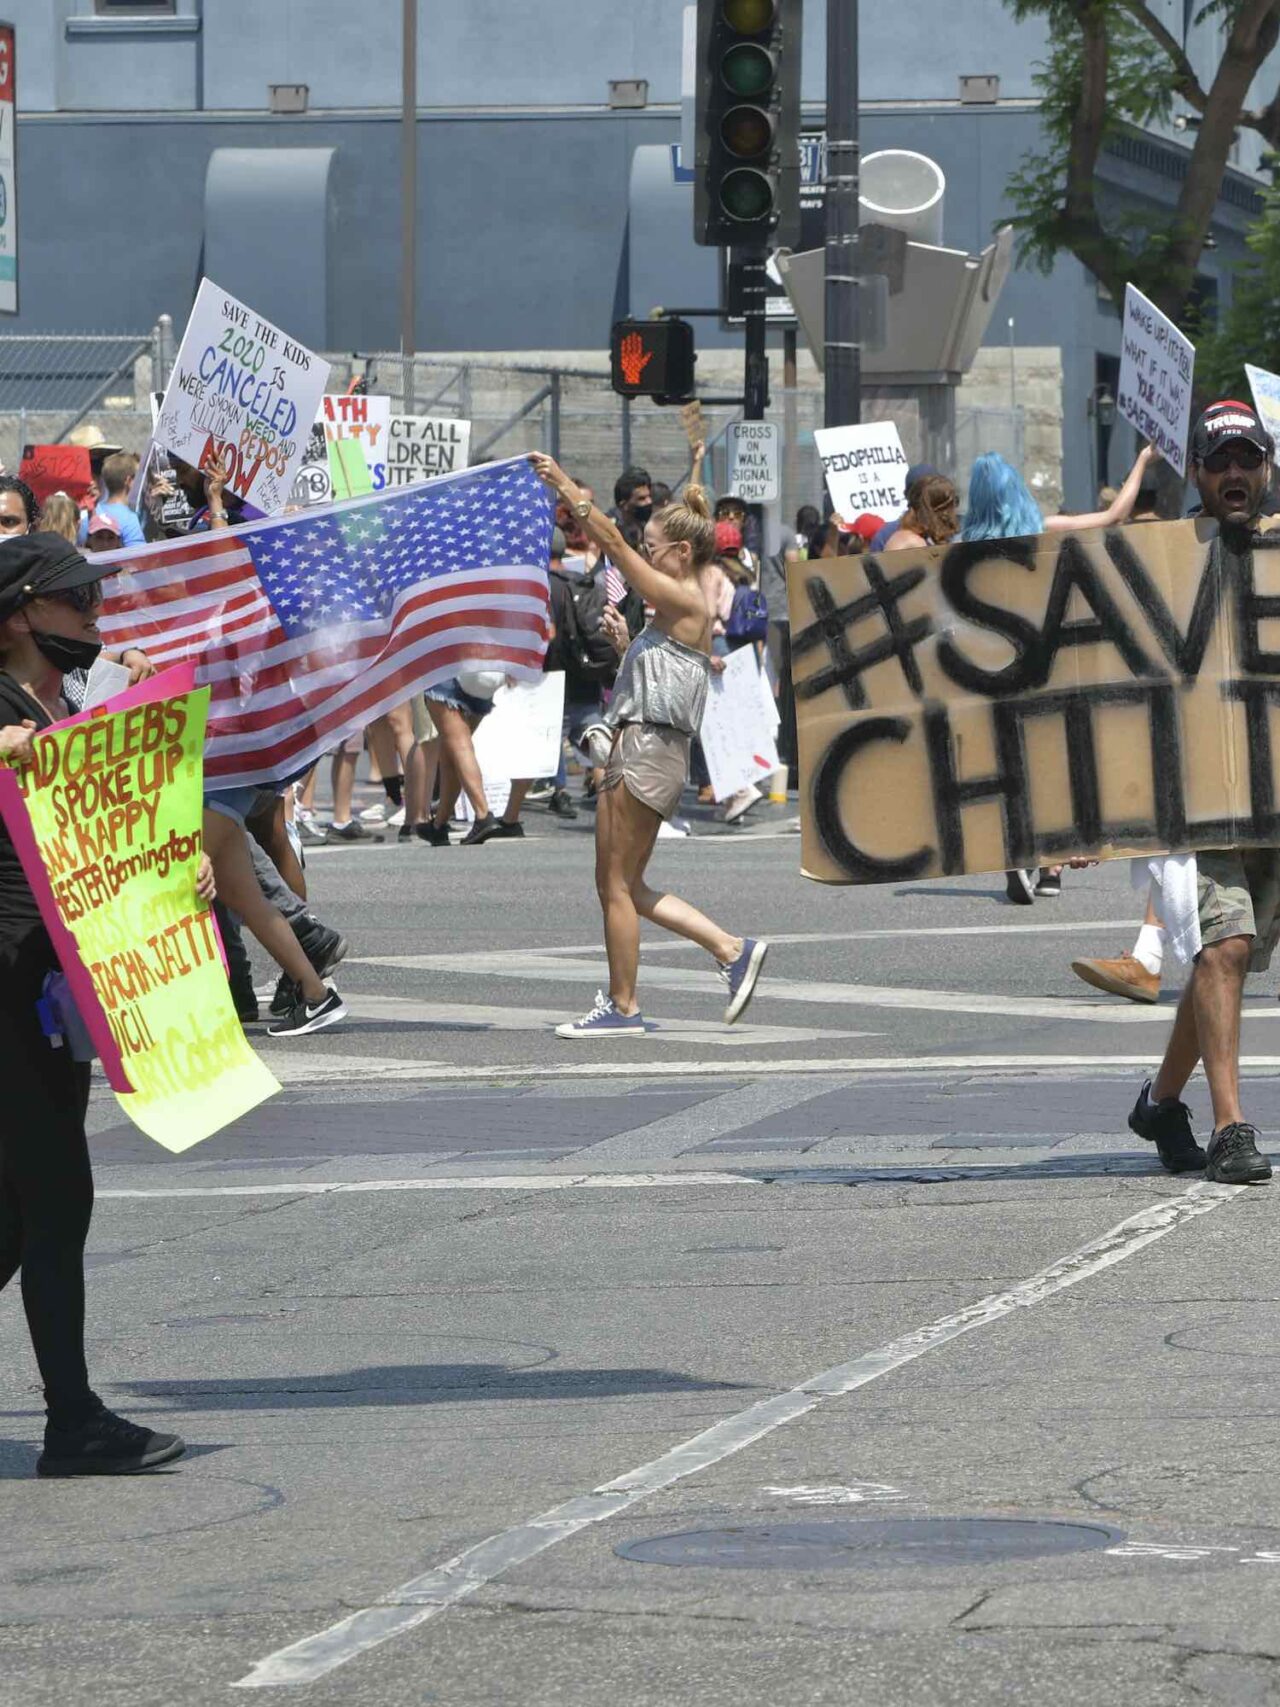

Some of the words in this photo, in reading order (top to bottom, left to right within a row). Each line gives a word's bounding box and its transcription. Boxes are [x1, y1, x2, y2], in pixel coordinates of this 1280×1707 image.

[221, 300, 250, 330] SAVE
[254, 321, 279, 350] THE
[282, 340, 312, 372] KIDS
[217, 327, 266, 374] 2020
[270, 366, 286, 391] IS
[1125, 336, 1148, 369] WHAT
[199, 345, 297, 438] CANCELED
[179, 368, 208, 401] WERE
[208, 393, 244, 424] SMOKIN
[246, 411, 276, 443] WEED
[278, 438, 297, 458] AND
[1204, 414, 1256, 431] TRUMP
[421, 421, 462, 443] ALL
[733, 425, 772, 439] CROSS
[746, 441, 760, 452] ON
[198, 431, 263, 499] NOW
[738, 453, 768, 466] WALK
[821, 445, 906, 472] PEDOPHILIA
[732, 468, 772, 481] SIGNAL
[858, 472, 868, 484] IS
[873, 471, 881, 482] A
[738, 484, 767, 497] ONLY
[849, 487, 900, 510] CRIME
[63, 695, 189, 783] CELEBS
[51, 761, 133, 828] SPOKE
[74, 791, 162, 869] KAPPY
[146, 910, 215, 985] JAITT
